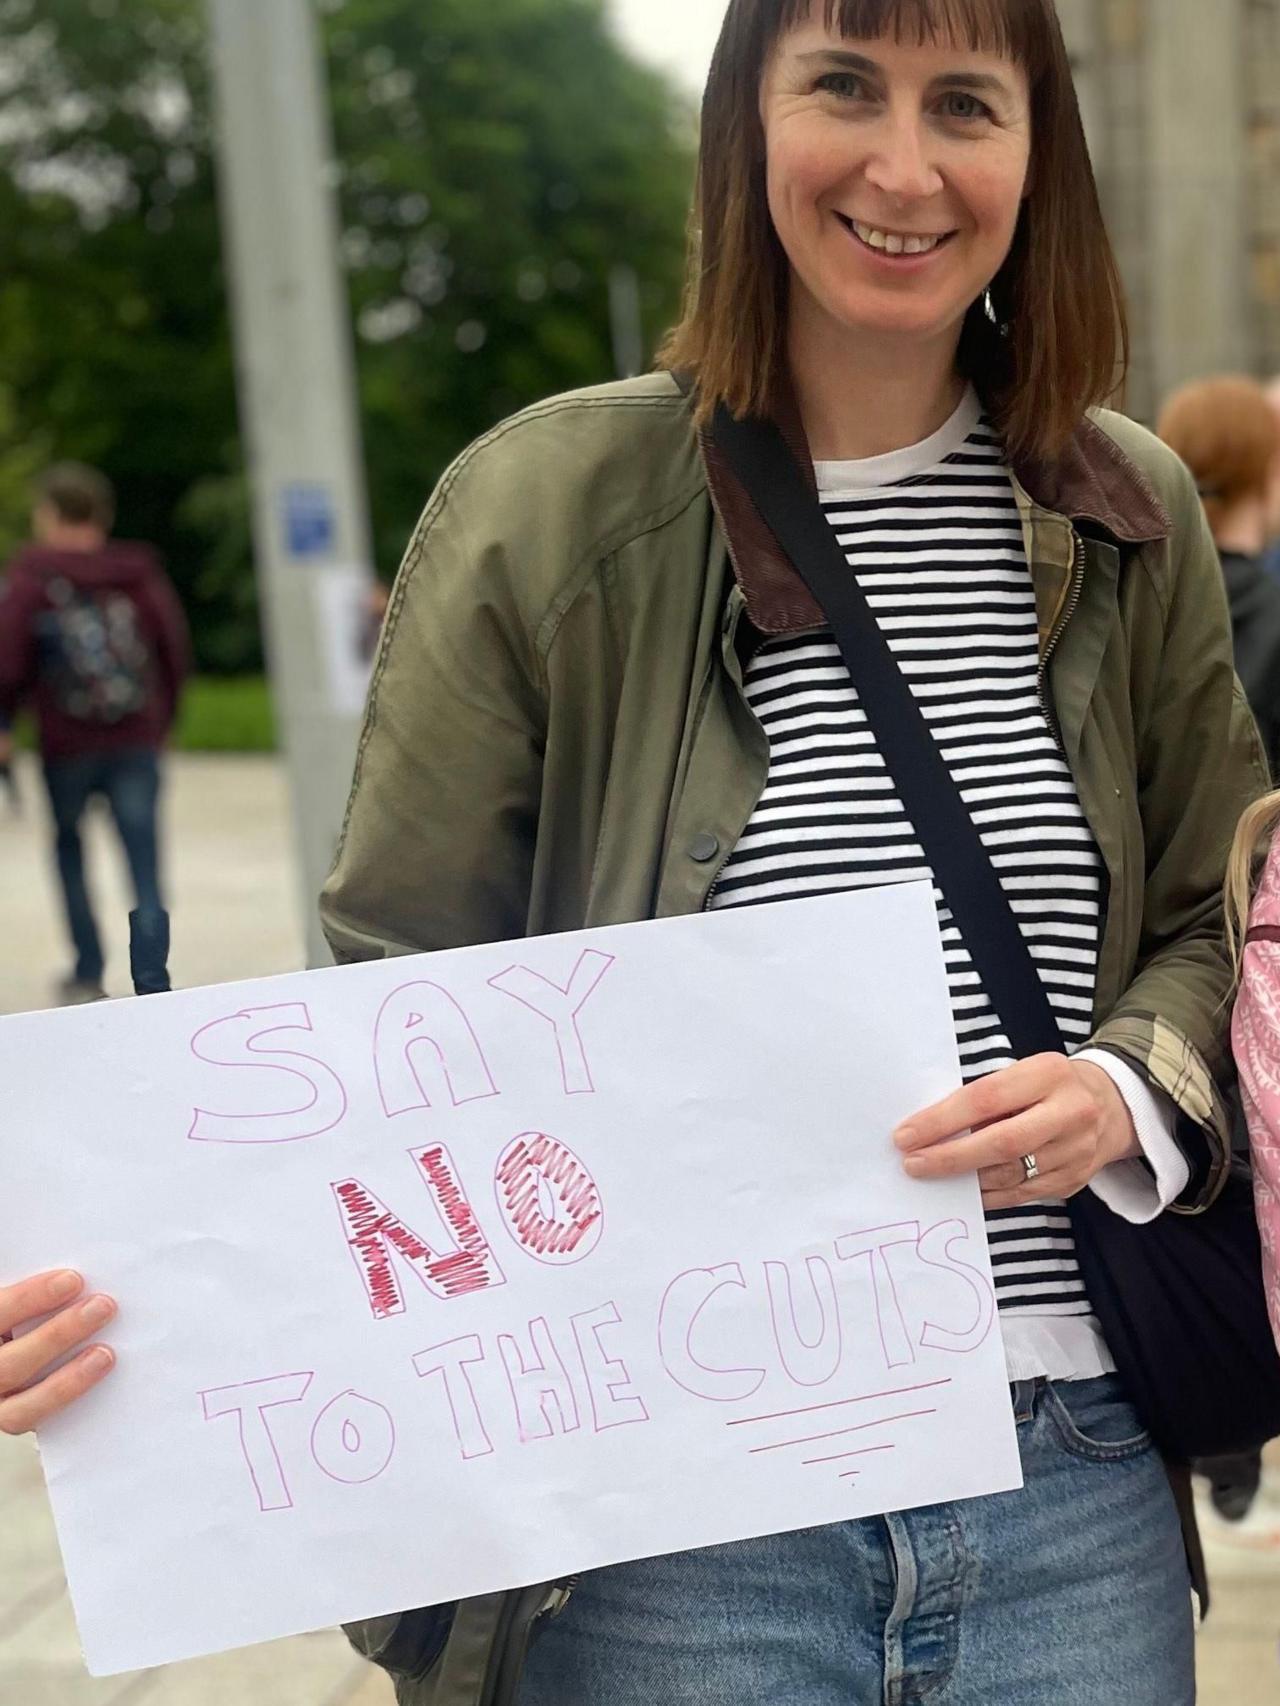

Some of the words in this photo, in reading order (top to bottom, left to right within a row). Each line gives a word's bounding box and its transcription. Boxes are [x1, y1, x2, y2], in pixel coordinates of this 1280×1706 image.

[188, 949, 614, 1143] SAY
[331, 1132, 604, 1319] NO
[199, 1372, 395, 1512] TO
[412, 1302, 649, 1459] THE
[658, 1218, 994, 1401] CUTS
